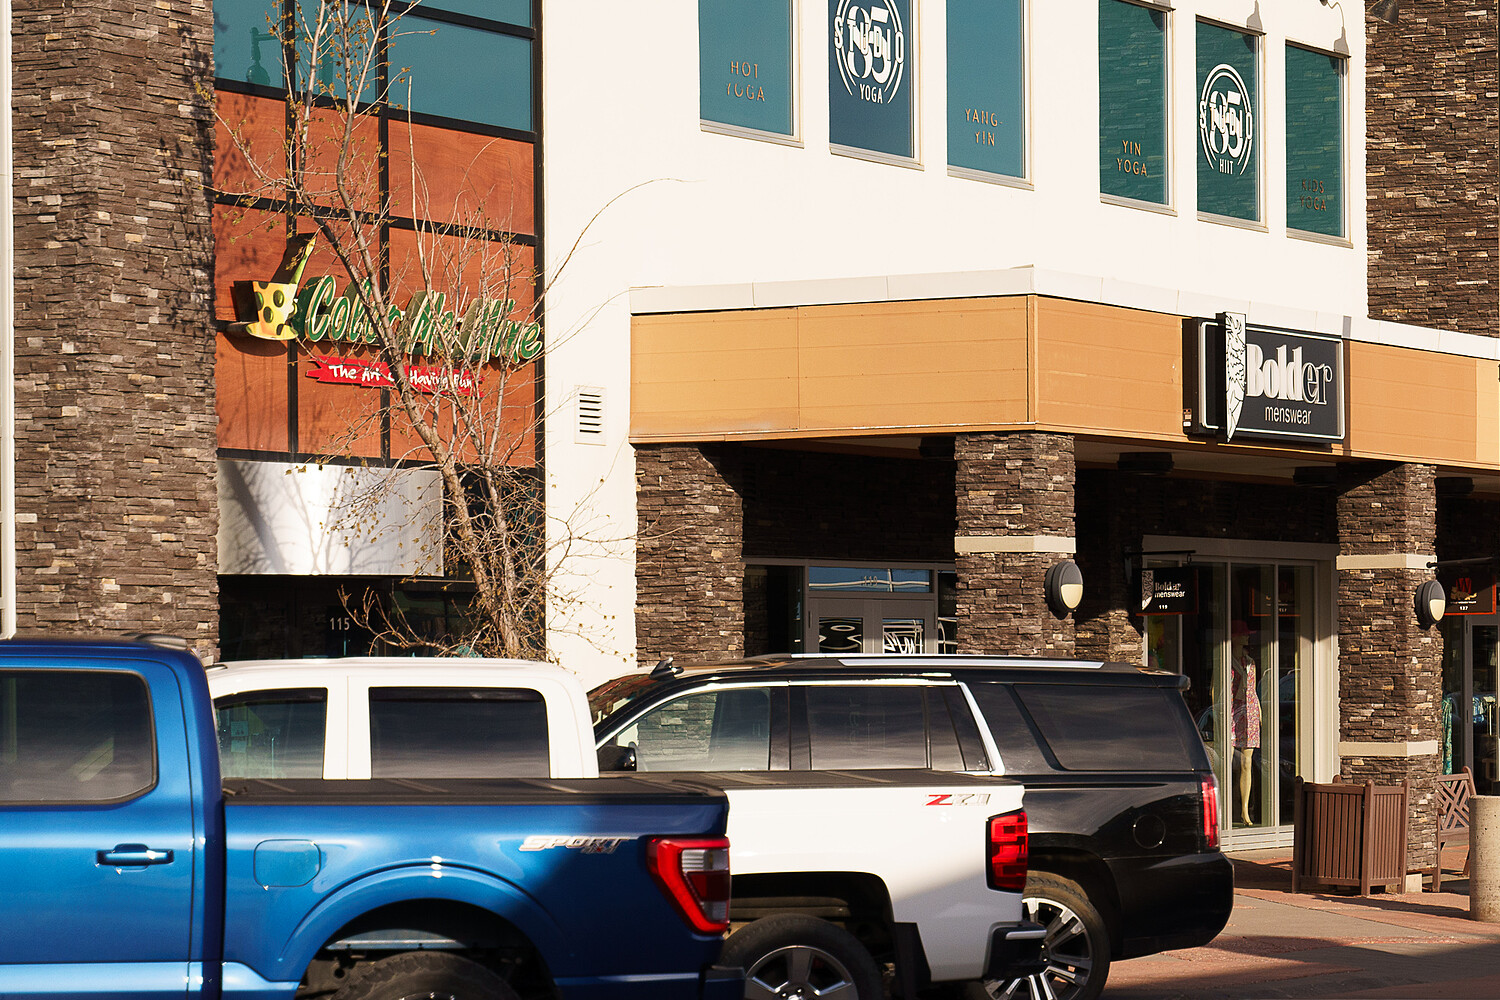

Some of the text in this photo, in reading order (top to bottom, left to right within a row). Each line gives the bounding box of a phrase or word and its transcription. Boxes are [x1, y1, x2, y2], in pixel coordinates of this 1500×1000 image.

[834, 16, 905, 66] STUDIO
[730, 60, 760, 80] HOT
[726, 82, 766, 102] YOGA
[859, 83, 884, 104] YOGA
[1199, 100, 1253, 140] STUDIO
[975, 131, 996, 147] YIN
[1122, 140, 1142, 156] YIN
[1116, 158, 1148, 177] YOGA
[1219, 158, 1234, 175] HIIT
[1301, 179, 1325, 194] KIDS
[1300, 196, 1327, 212] YOGA
[328, 364, 357, 379] The
[361, 366, 381, 382] Art
[1246, 343, 1333, 405] Bolder
[1264, 406, 1312, 425] menswear
[1155, 581, 1182, 591] Bolder
[1154, 591, 1186, 599] menswear
[329, 617, 350, 631] 115
[519, 835, 630, 852] SPORT
